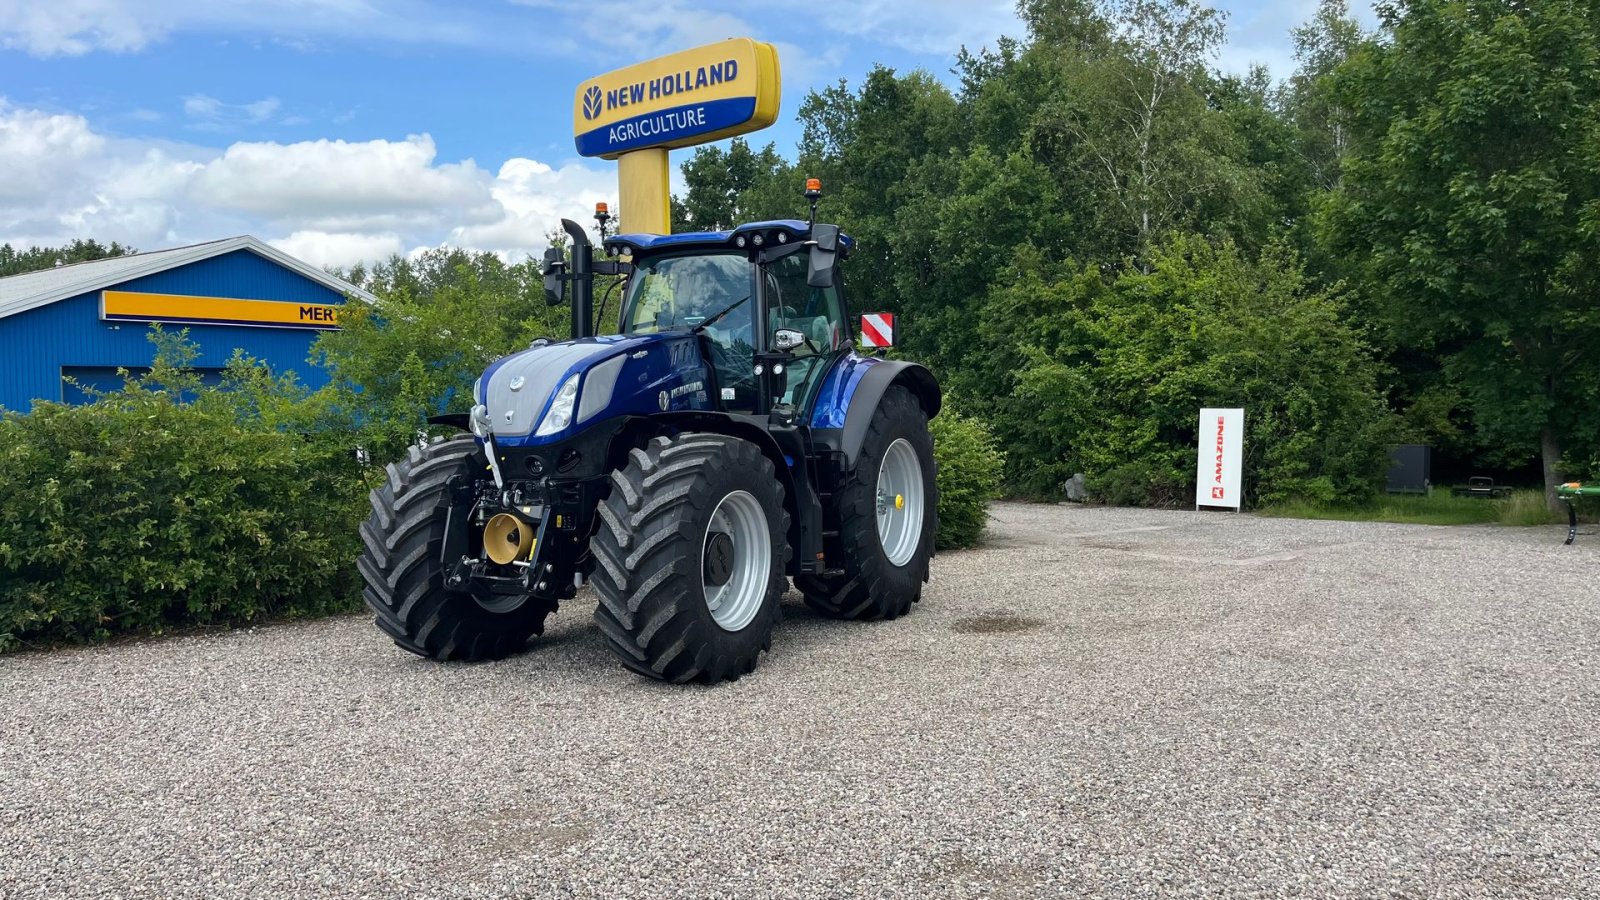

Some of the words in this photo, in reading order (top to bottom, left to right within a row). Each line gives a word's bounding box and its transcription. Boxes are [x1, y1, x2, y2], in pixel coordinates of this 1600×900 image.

[607, 83, 645, 110] NEW
[649, 59, 738, 99] HOLLAND
[608, 107, 706, 144] AGRICULTURE
[300, 306, 339, 321] MER
[1215, 416, 1224, 483] AMAZONE
